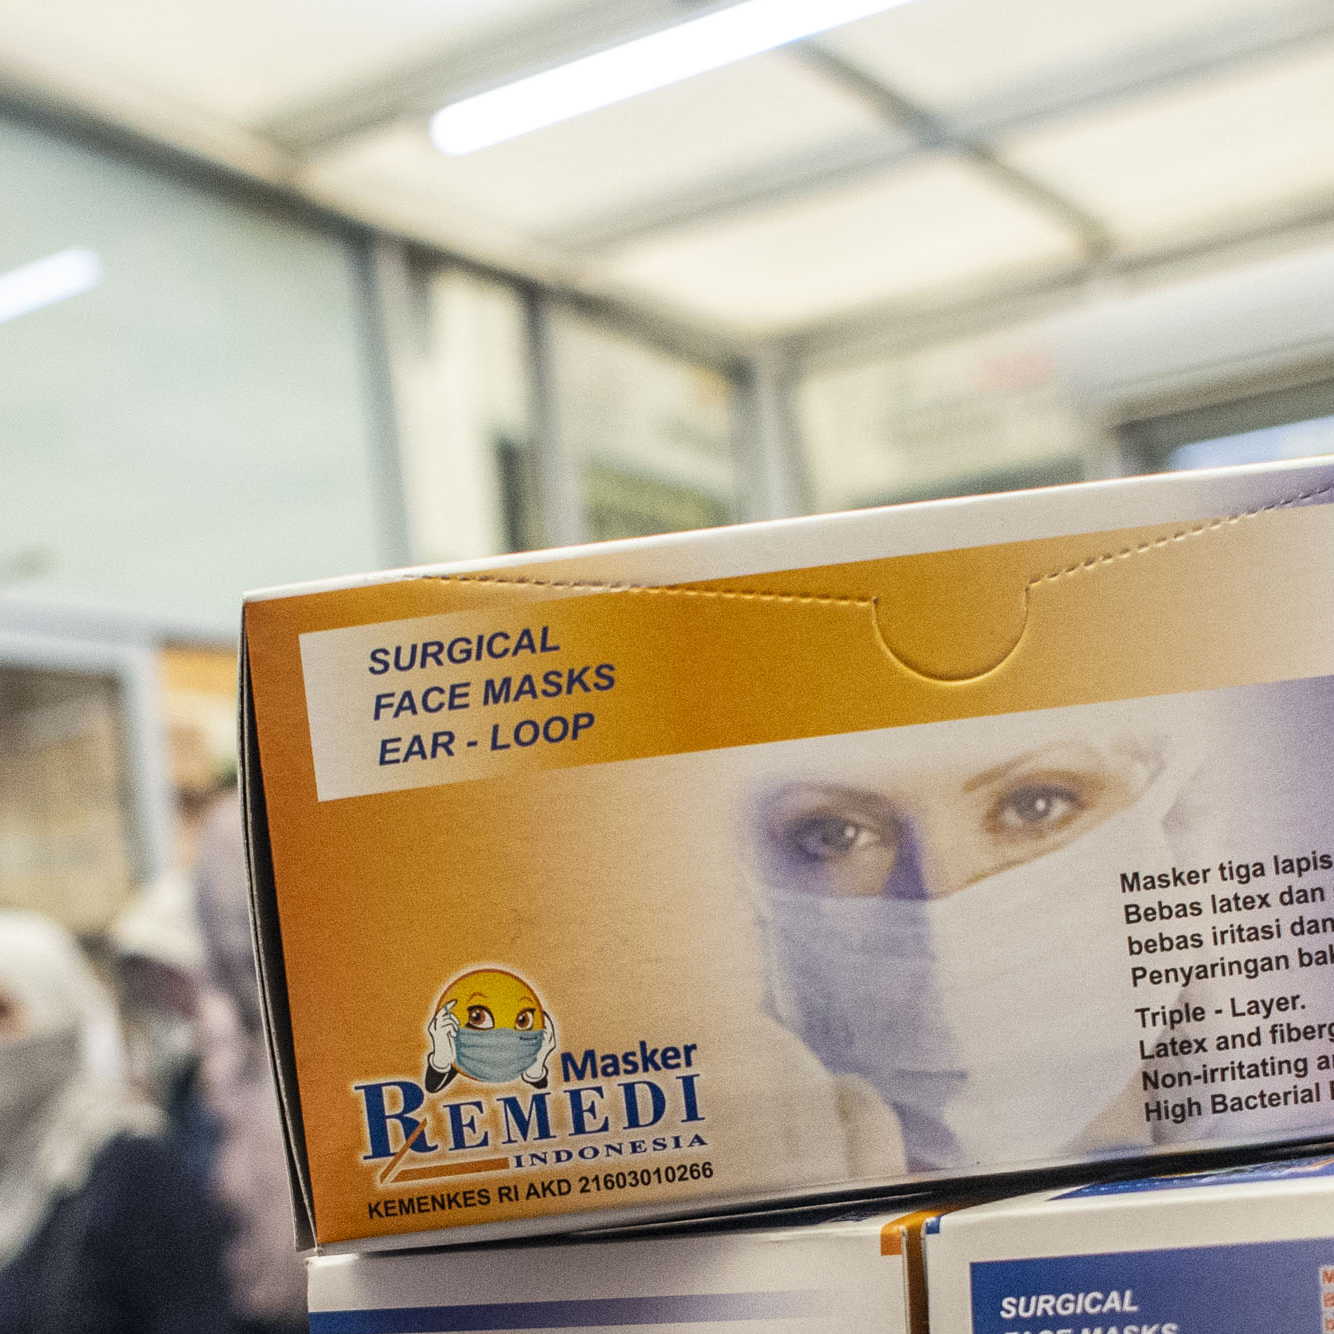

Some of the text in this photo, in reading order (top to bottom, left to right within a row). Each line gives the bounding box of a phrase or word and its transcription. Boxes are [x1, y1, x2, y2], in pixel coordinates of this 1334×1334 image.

[368, 625, 561, 676] SURGICAL
[372, 662, 616, 722] FACE MASKS
[378, 730, 456, 767] EAR
[490, 711, 596, 752] LOOP
[1119, 866, 1212, 894] Masker
[1217, 859, 1267, 886] tiga
[1123, 899, 1204, 926] Bebas
[1210, 891, 1272, 915] latex
[1278, 884, 1326, 907] dan
[1126, 931, 1205, 957] bebas
[1211, 917, 1283, 947] iritasi
[1130, 953, 1291, 989] Penyaringan
[1133, 1001, 1207, 1032] Triple
[1229, 993, 1307, 1021] Layer.
[560, 1042, 698, 1083] Masker
[1138, 1035, 1209, 1061] Latex
[1215, 1025, 1263, 1052] and
[1141, 1055, 1309, 1092] Non-irritating
[354, 1073, 707, 1161] REMEDI
[1143, 1096, 1203, 1126] High
[1209, 1081, 1322, 1115] Bacterial
[514, 1133, 708, 1169] INDONESIA
[367, 1160, 715, 1220] KEMENKES RI AKD 21603010266
[999, 1289, 1139, 1320] SURGICAL
